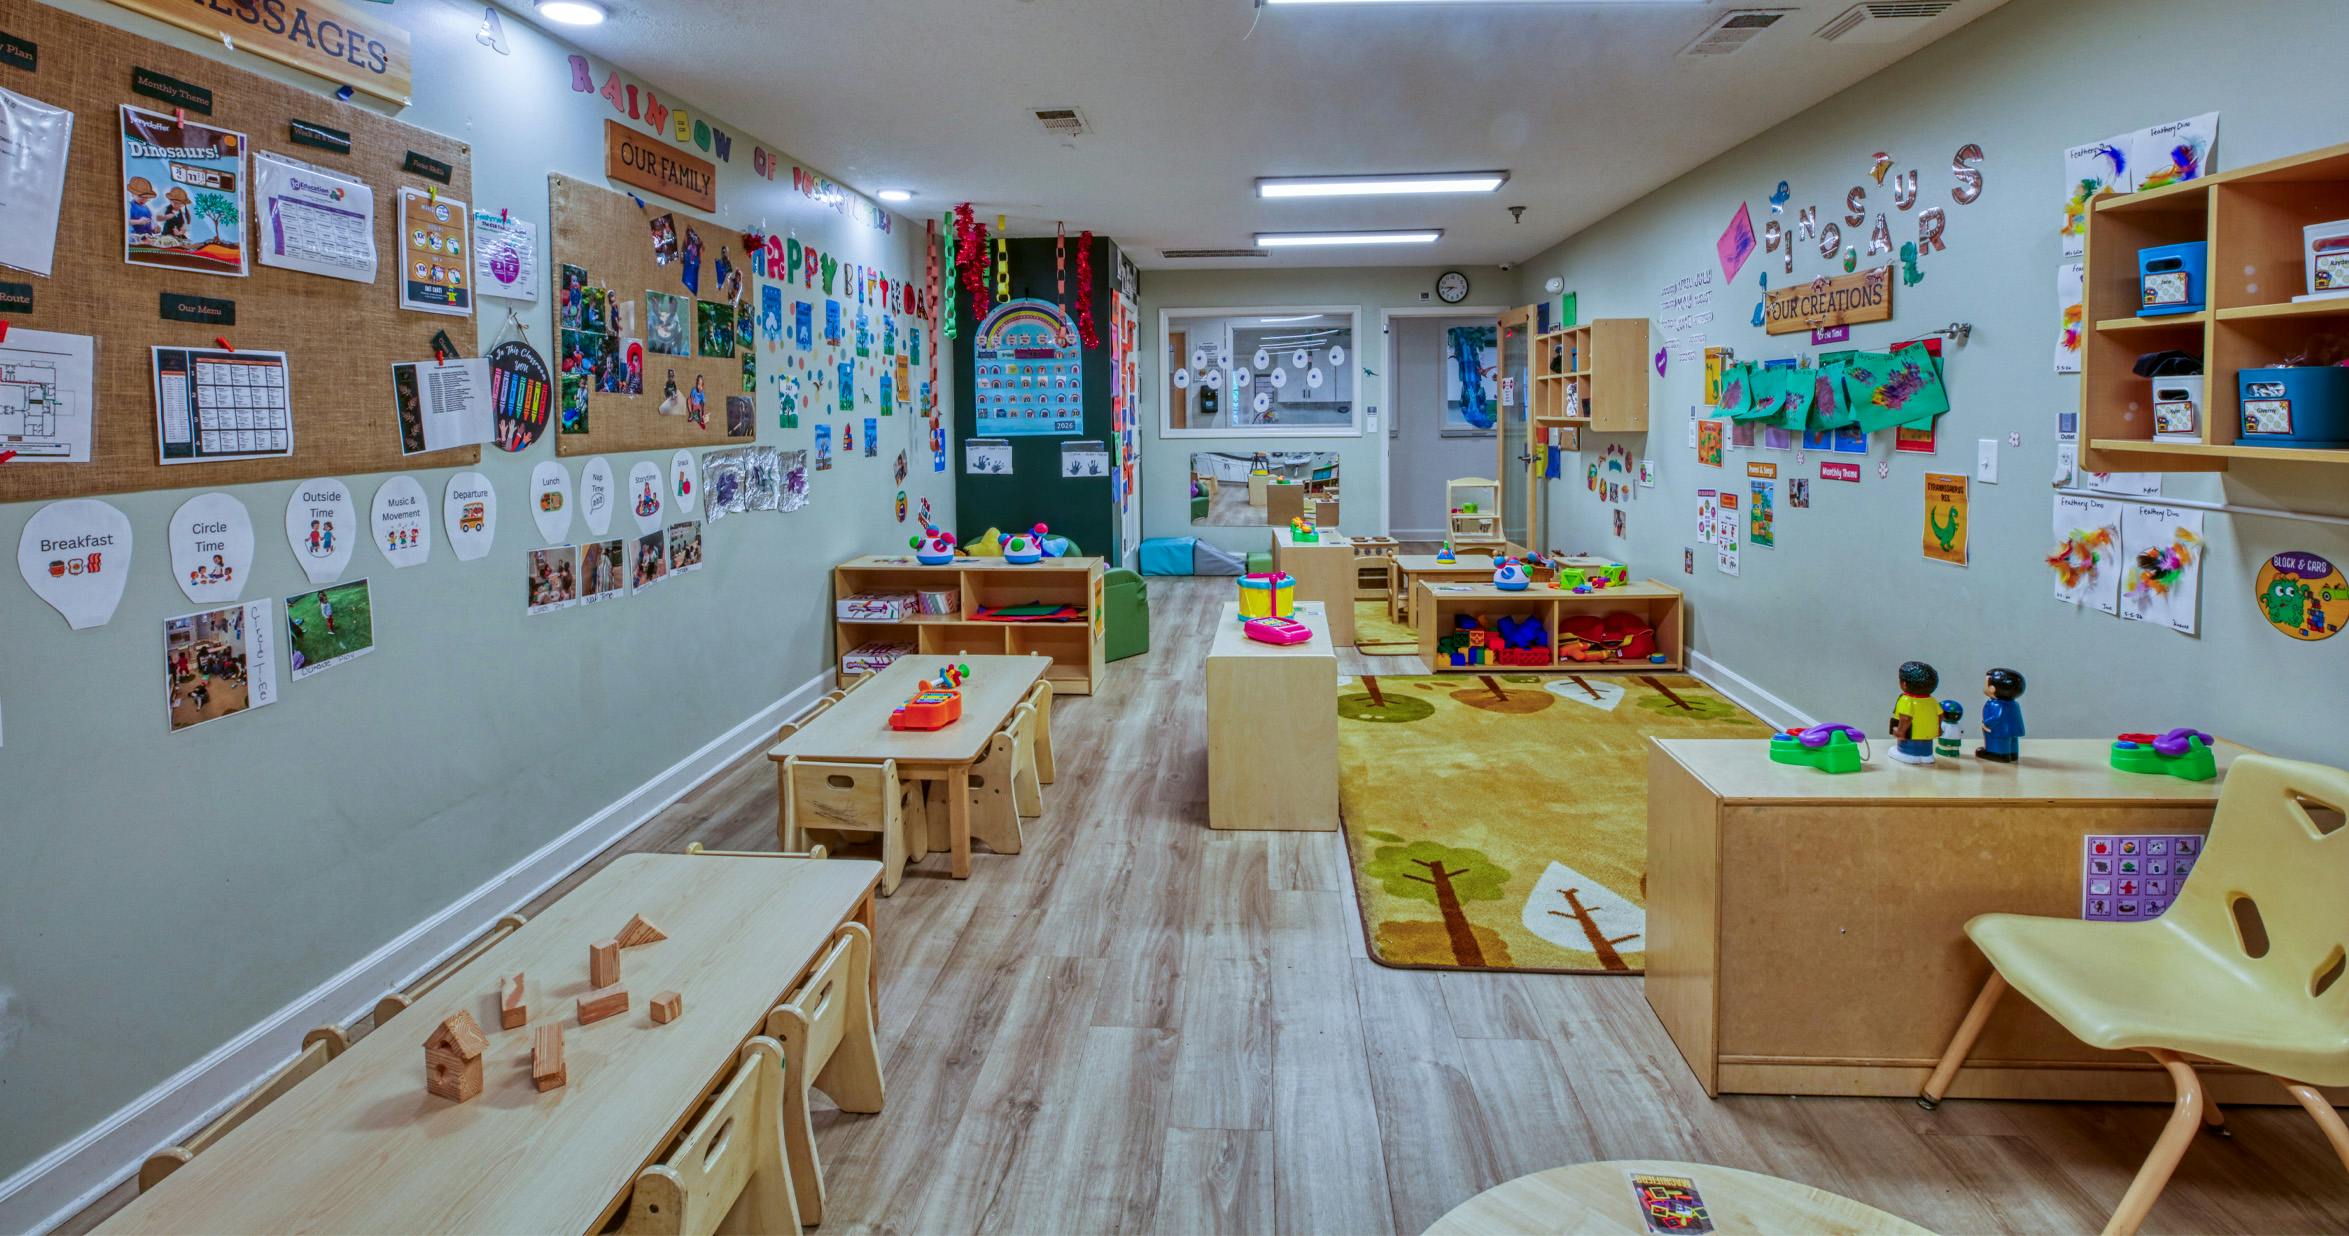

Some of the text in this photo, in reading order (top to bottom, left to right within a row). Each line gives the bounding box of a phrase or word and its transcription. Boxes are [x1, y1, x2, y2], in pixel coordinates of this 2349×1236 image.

[193, 0, 388, 74] SSAGES
[6, 43, 34, 61] Plan
[137, 75, 211, 107] Monthly Theme
[567, 54, 732, 164] RAINBOW
[753, 145, 777, 181] OF
[128, 141, 220, 160] Dinosaurs!
[620, 141, 712, 197] OUR FAMILY
[0, 292, 31, 305] Route
[844, 262, 929, 321] BIRTHDA
[1771, 283, 1883, 321] OUR CREATIONS
[177, 303, 222, 316] Our Menu
[592, 473, 603, 482] Nap
[1822, 466, 1858, 480] Monthly Theme
[542, 477, 561, 487] Lunch
[592, 484, 604, 493] Time
[302, 491, 342, 503] Outside
[387, 495, 416, 508] Music &
[453, 489, 489, 501] Departure
[2060, 497, 2089, 511] Feathery
[309, 507, 335, 518] Time
[381, 508, 421, 521] Movement
[192, 521, 228, 535] Circle
[40, 533, 115, 553] Breakfast
[195, 539, 225, 553] Time
[2273, 555, 2328, 574] BLOCK & CARS
